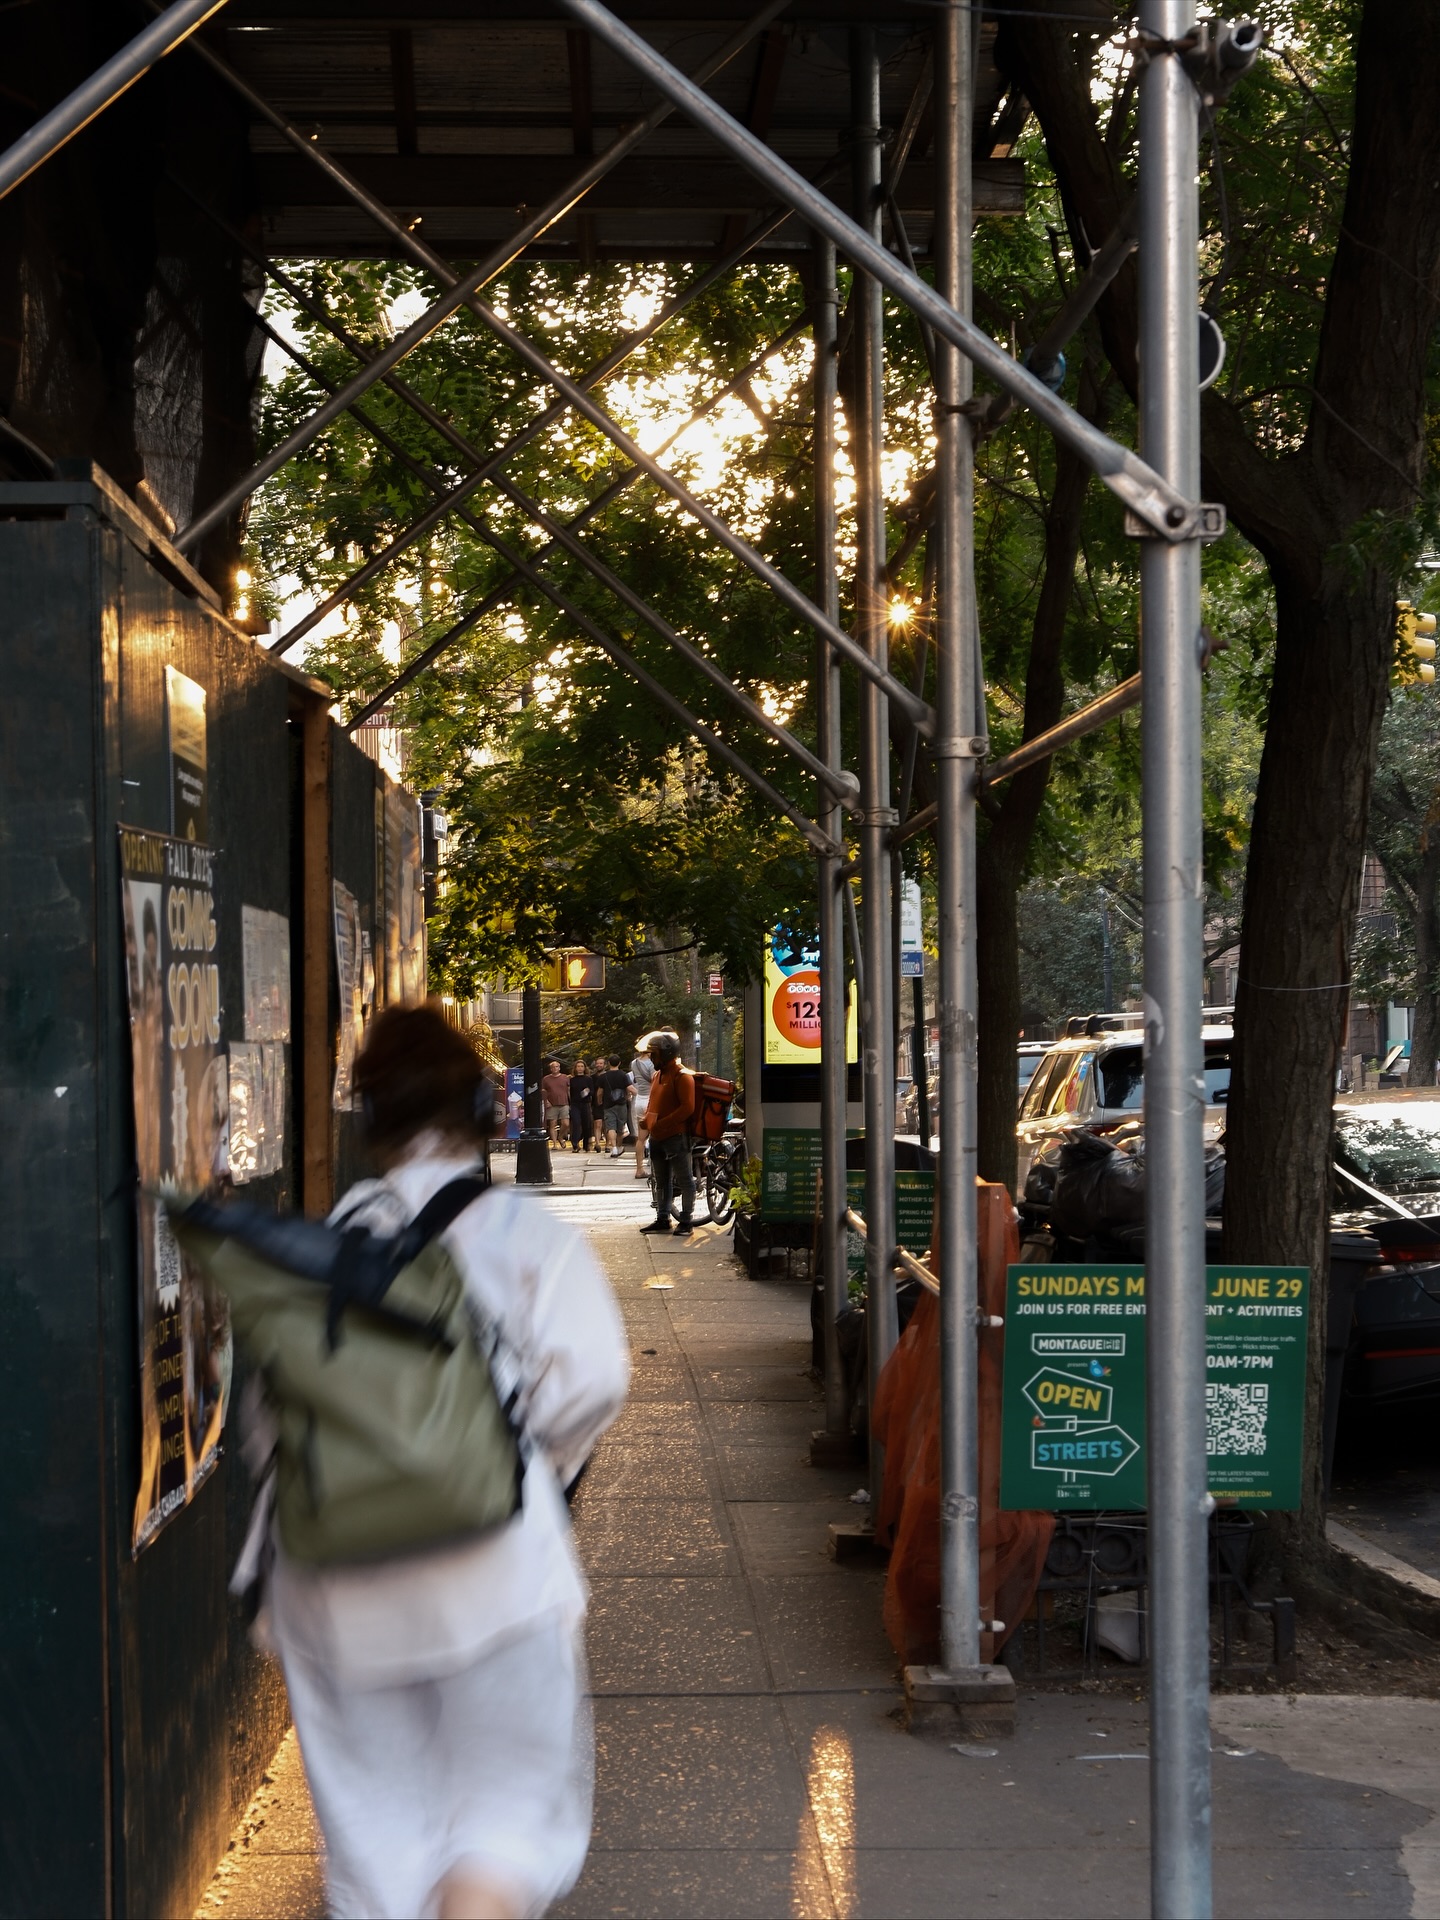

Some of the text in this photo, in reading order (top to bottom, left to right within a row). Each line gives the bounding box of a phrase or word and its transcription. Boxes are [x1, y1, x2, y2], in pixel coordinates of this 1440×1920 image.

[168, 842, 189, 879] FALL
[167, 885, 217, 952] COMING
[788, 984, 820, 994] POWE
[167, 962, 219, 1049] SOON!
[1017, 1276, 1303, 1298] SUNDAYS M JUNE 29
[1016, 1304, 1045, 1315] JOIN
[1048, 1304, 1064, 1315] US
[1067, 1304, 1091, 1315] FOR
[1094, 1304, 1123, 1315] FREE
[1126, 1304, 1146, 1315] ENT
[1237, 1305, 1303, 1317] ACTIVITIES
[1039, 1339, 1103, 1350] MONTAGUE
[1206, 1355, 1273, 1369] 0AM-7PM
[1037, 1381, 1103, 1412] OPEN
[1037, 1440, 1123, 1462] STREETS
